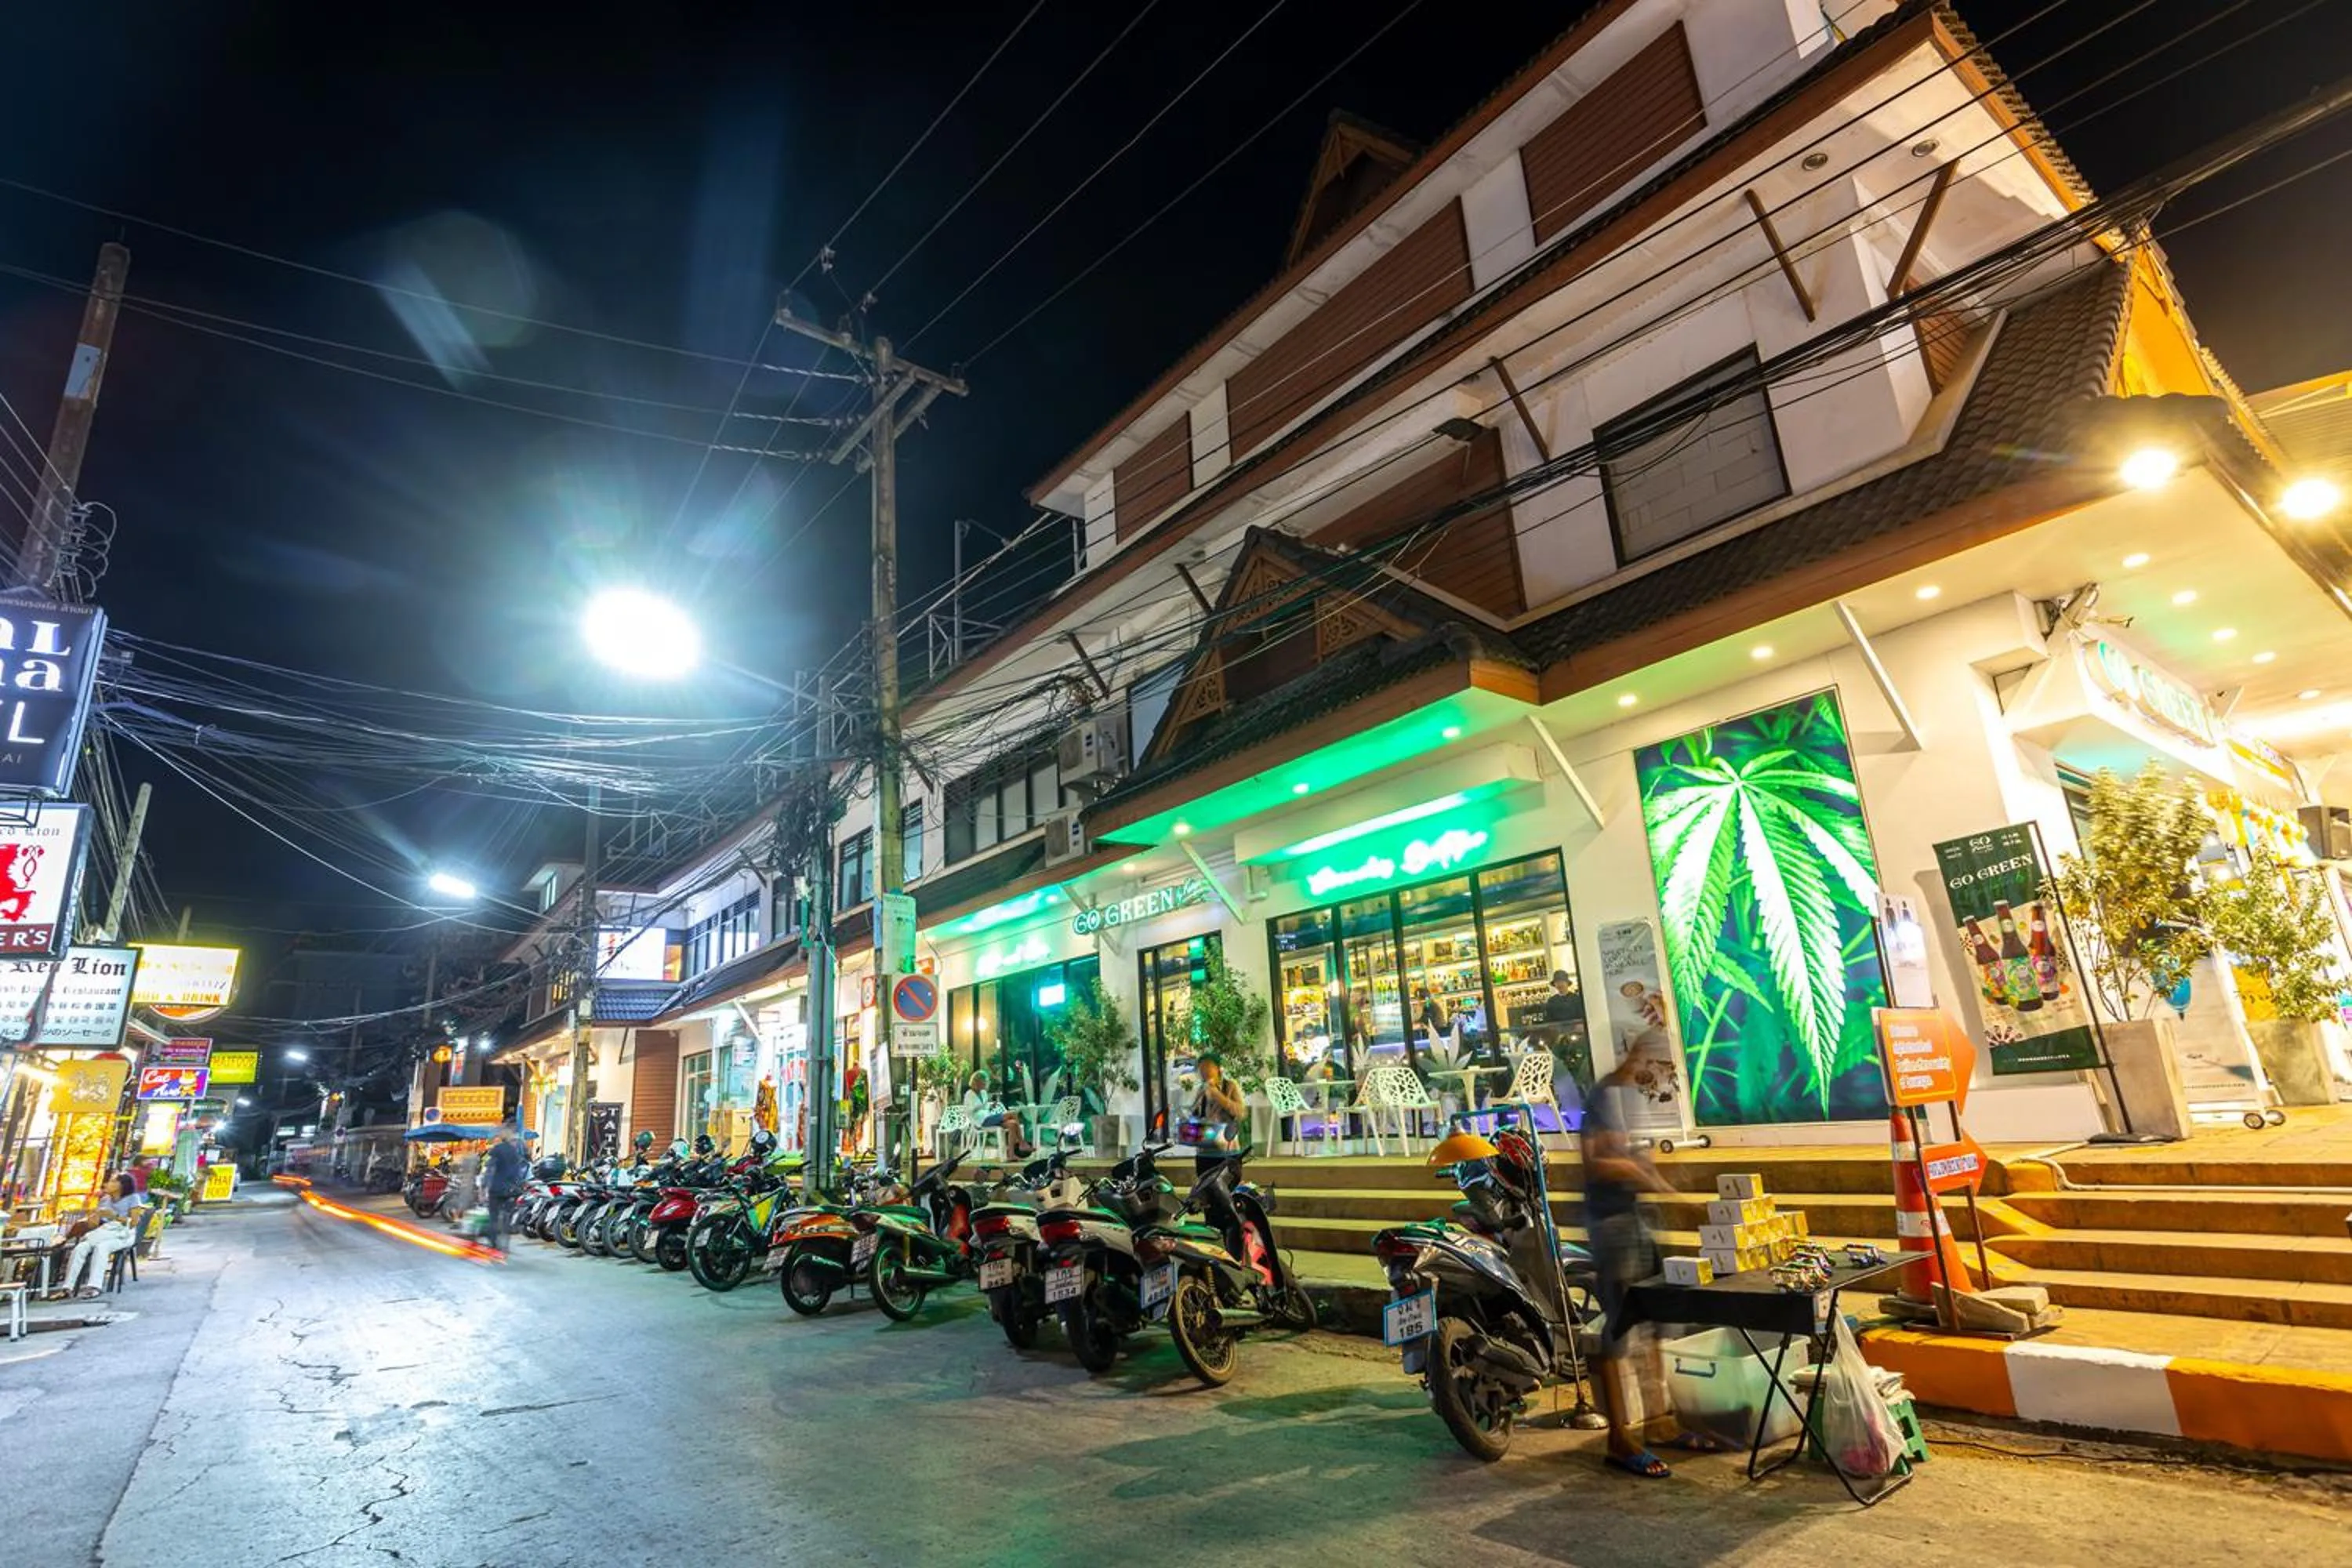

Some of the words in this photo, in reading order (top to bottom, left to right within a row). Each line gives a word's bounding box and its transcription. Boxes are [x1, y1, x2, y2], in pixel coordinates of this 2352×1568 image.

[1950, 873, 1975, 890] GO
[1976, 852, 2034, 880] GREEN
[1075, 909, 1100, 934] GO
[1105, 887, 1174, 926] GREEN
[71, 956, 128, 977] Lion
